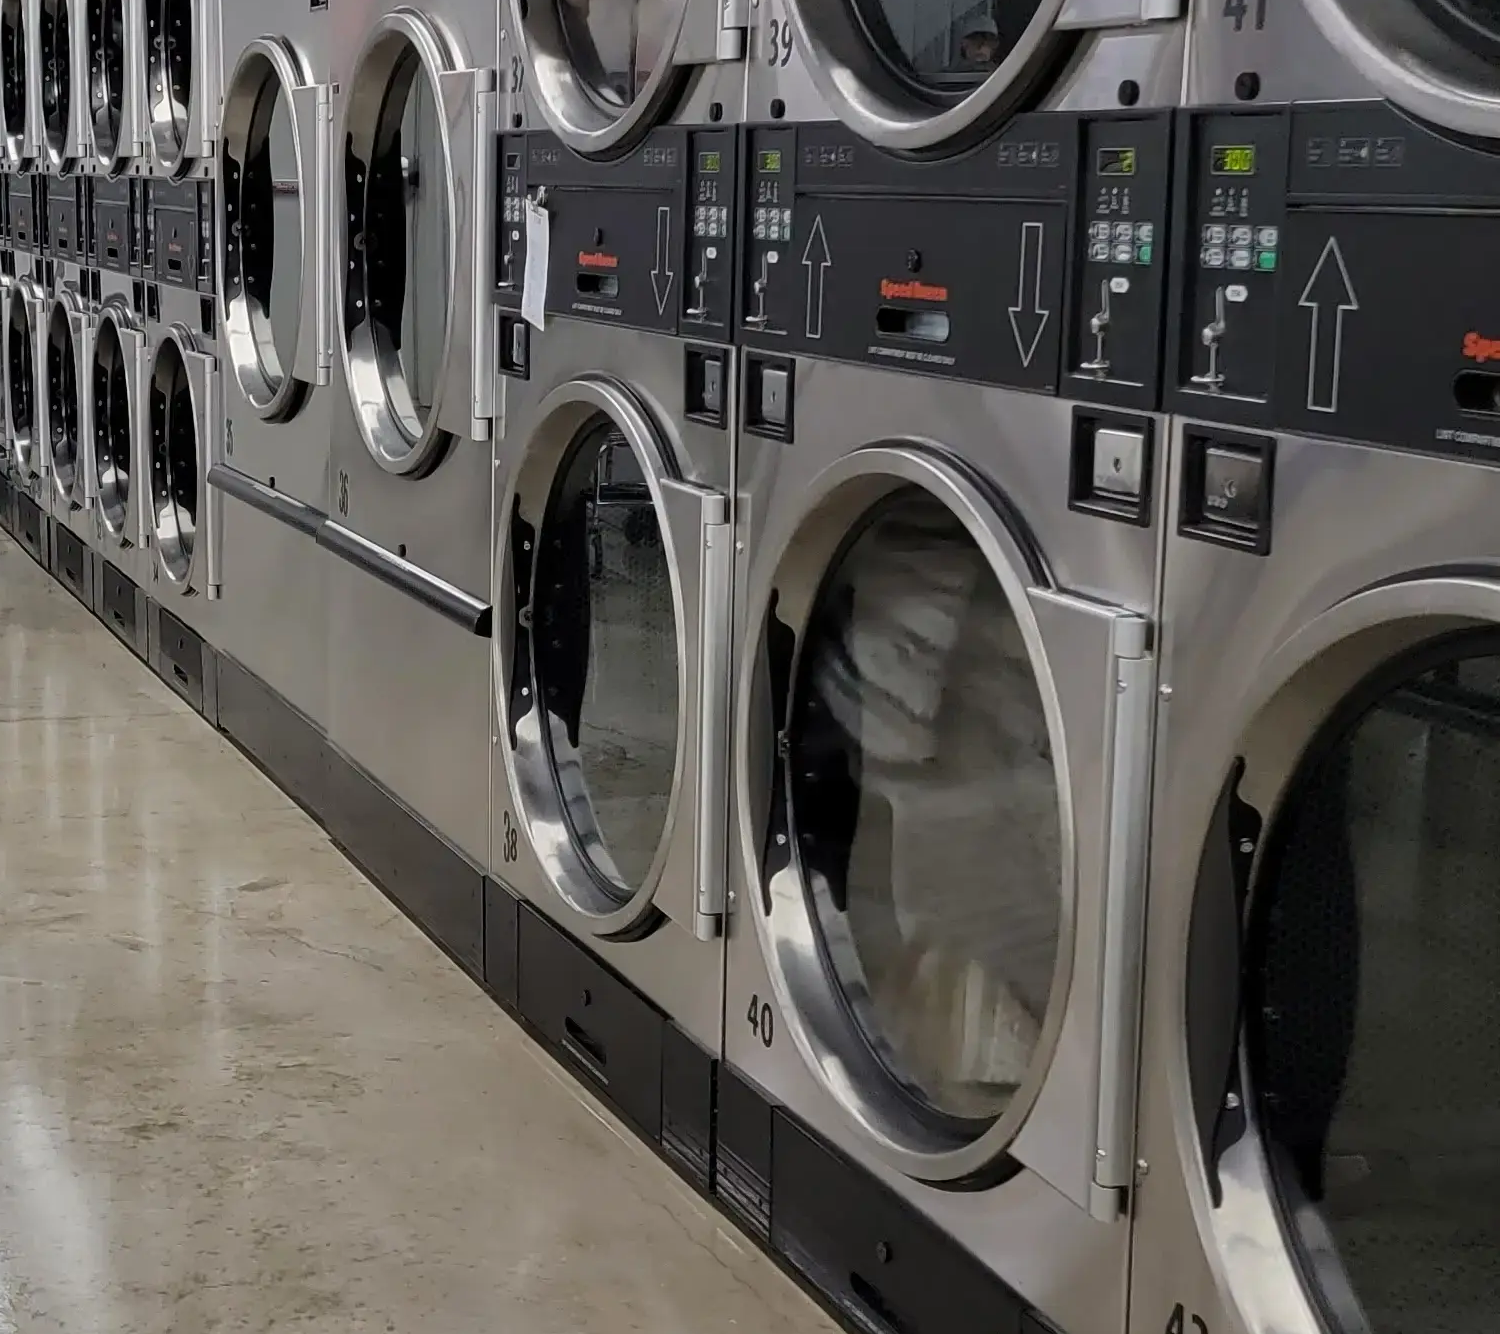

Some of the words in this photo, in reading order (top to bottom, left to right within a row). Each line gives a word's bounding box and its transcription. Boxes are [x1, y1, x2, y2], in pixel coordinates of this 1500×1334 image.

[769, 18, 793, 67] 39
[339, 469, 349, 517] 36
[503, 810, 518, 863] 38
[747, 994, 774, 1048] 40
